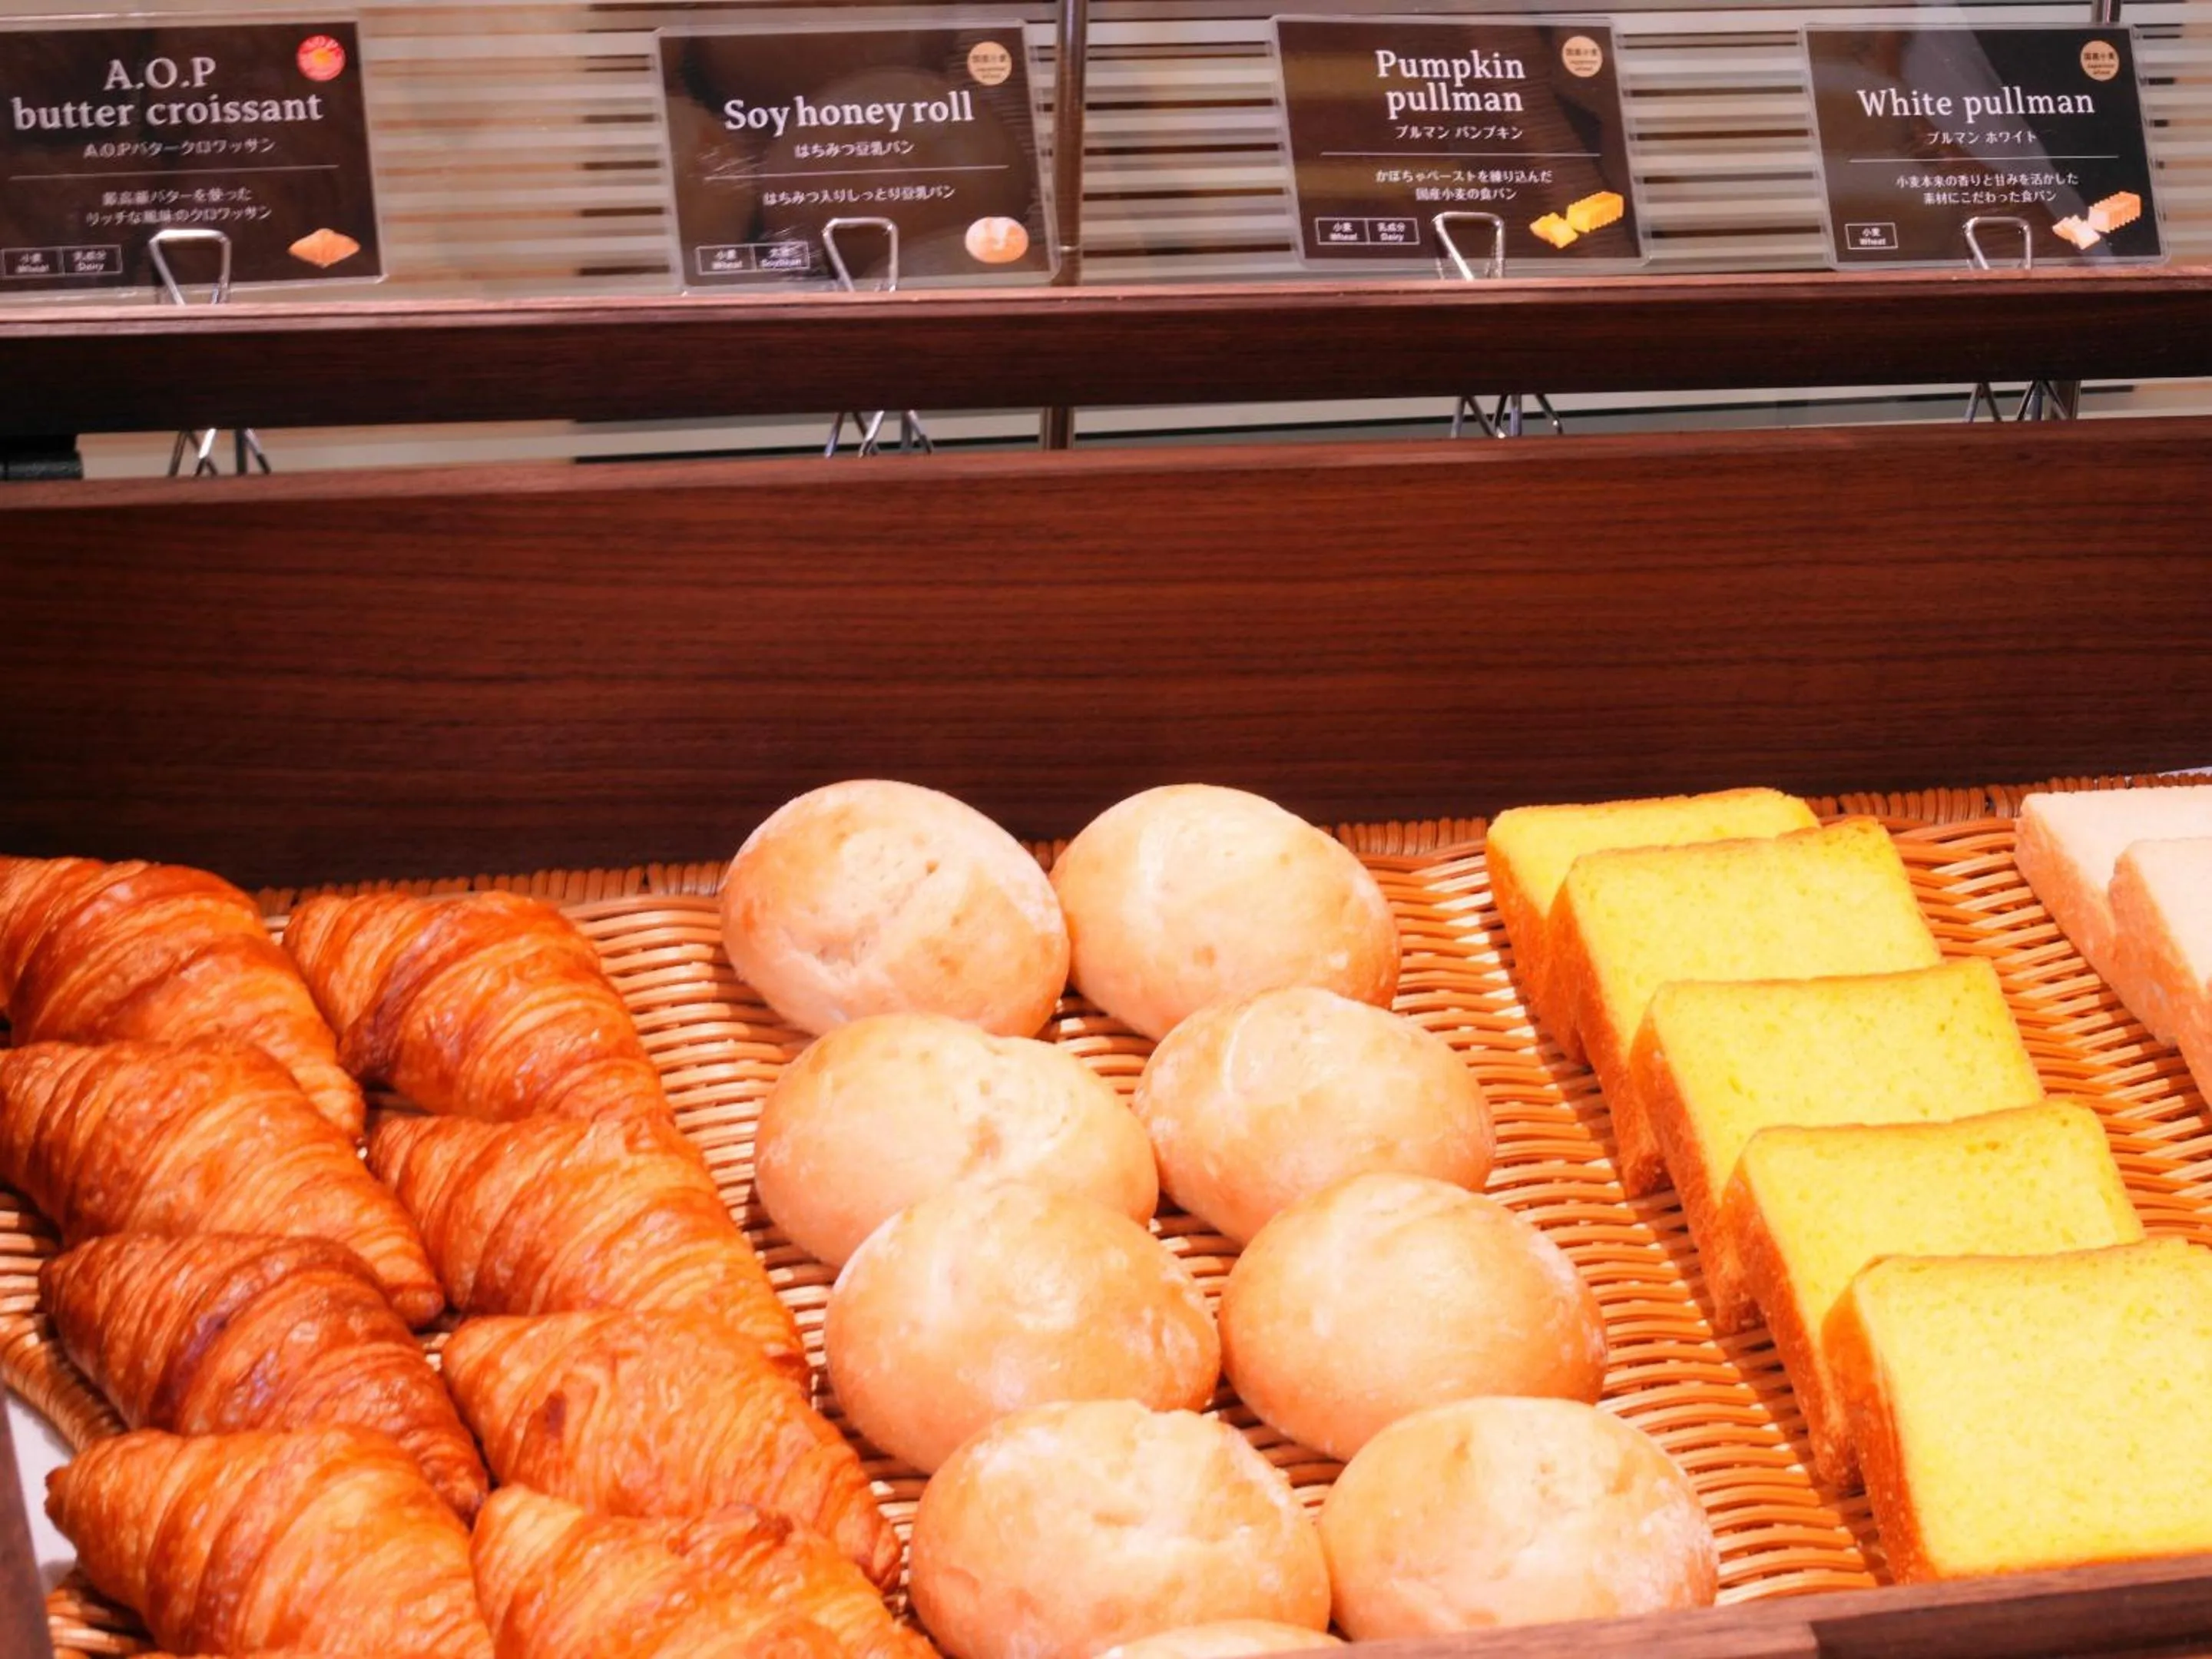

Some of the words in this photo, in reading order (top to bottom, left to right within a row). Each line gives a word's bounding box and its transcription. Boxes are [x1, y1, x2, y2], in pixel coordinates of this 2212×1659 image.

[104, 57, 217, 91] A.O.P
[1375, 50, 1526, 87] Pumpkin
[10, 97, 135, 131] butter
[146, 94, 324, 127] croissant
[724, 99, 790, 137] Soy
[794, 96, 907, 132] honey
[912, 90, 975, 123] roll
[1386, 82, 1525, 120] pullman
[1857, 88, 1952, 118] White
[1965, 87, 2095, 124] pullman
[794, 140, 916, 158] はちみつ豆乳パン
[1985, 130, 2038, 144] ホワイト
[1416, 187, 1518, 201] 国産小麦の食パン
